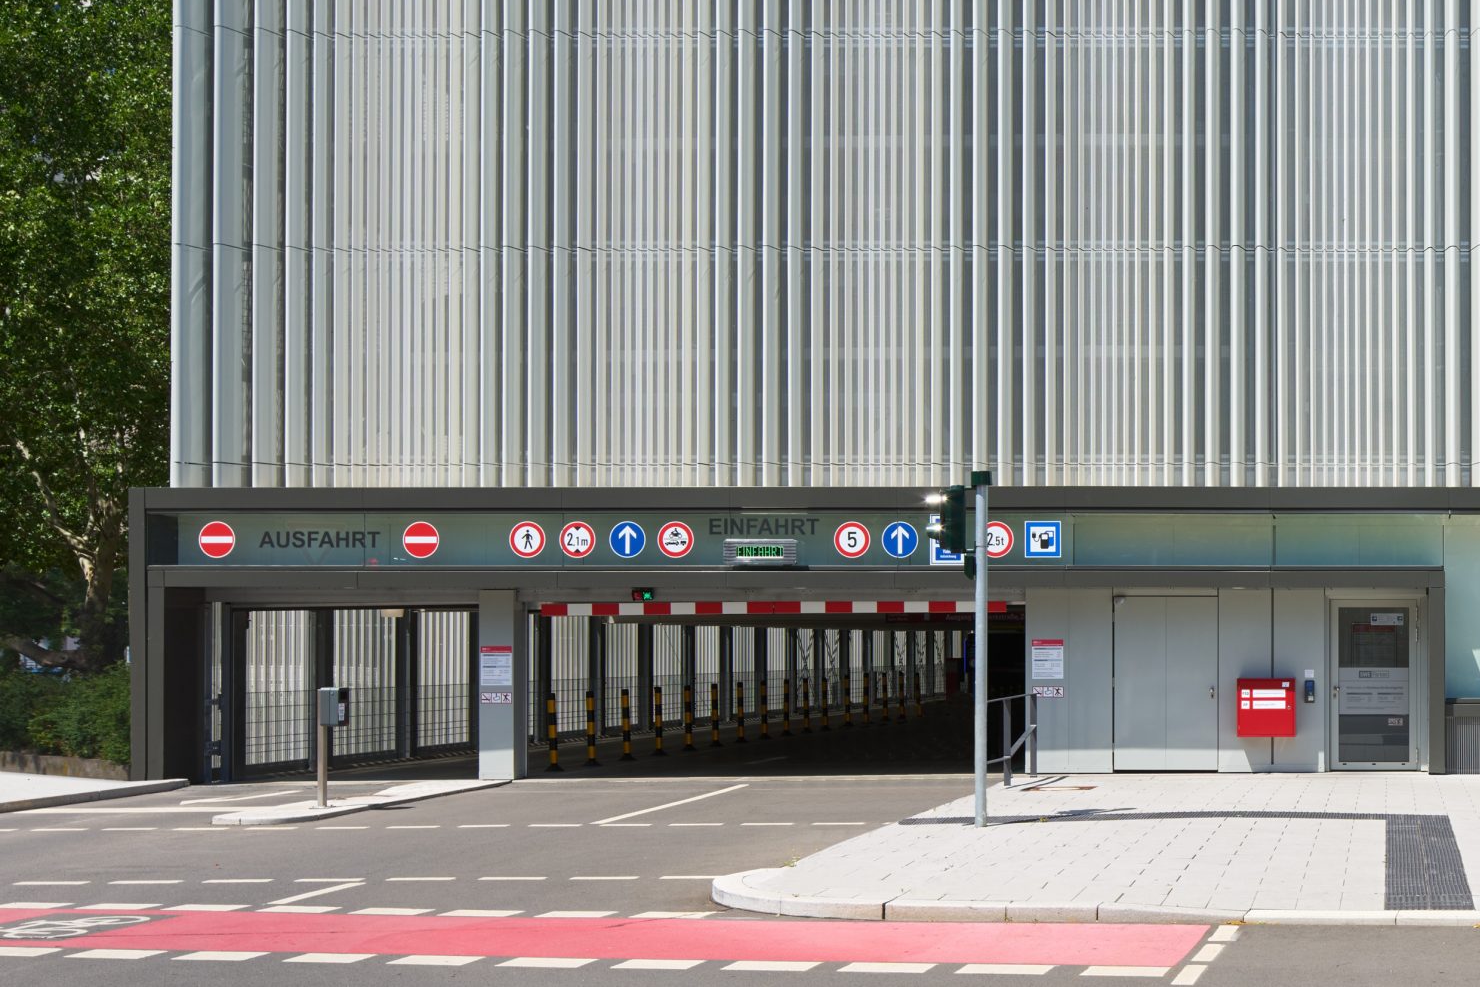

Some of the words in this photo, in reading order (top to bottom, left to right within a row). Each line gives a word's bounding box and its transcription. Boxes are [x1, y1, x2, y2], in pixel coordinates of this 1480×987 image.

[708, 517, 820, 536] EINFAHRT
[258, 530, 381, 549] AUSFAHRT
[847, 531, 858, 548] 5
[735, 545, 785, 558] EINFAHRT
